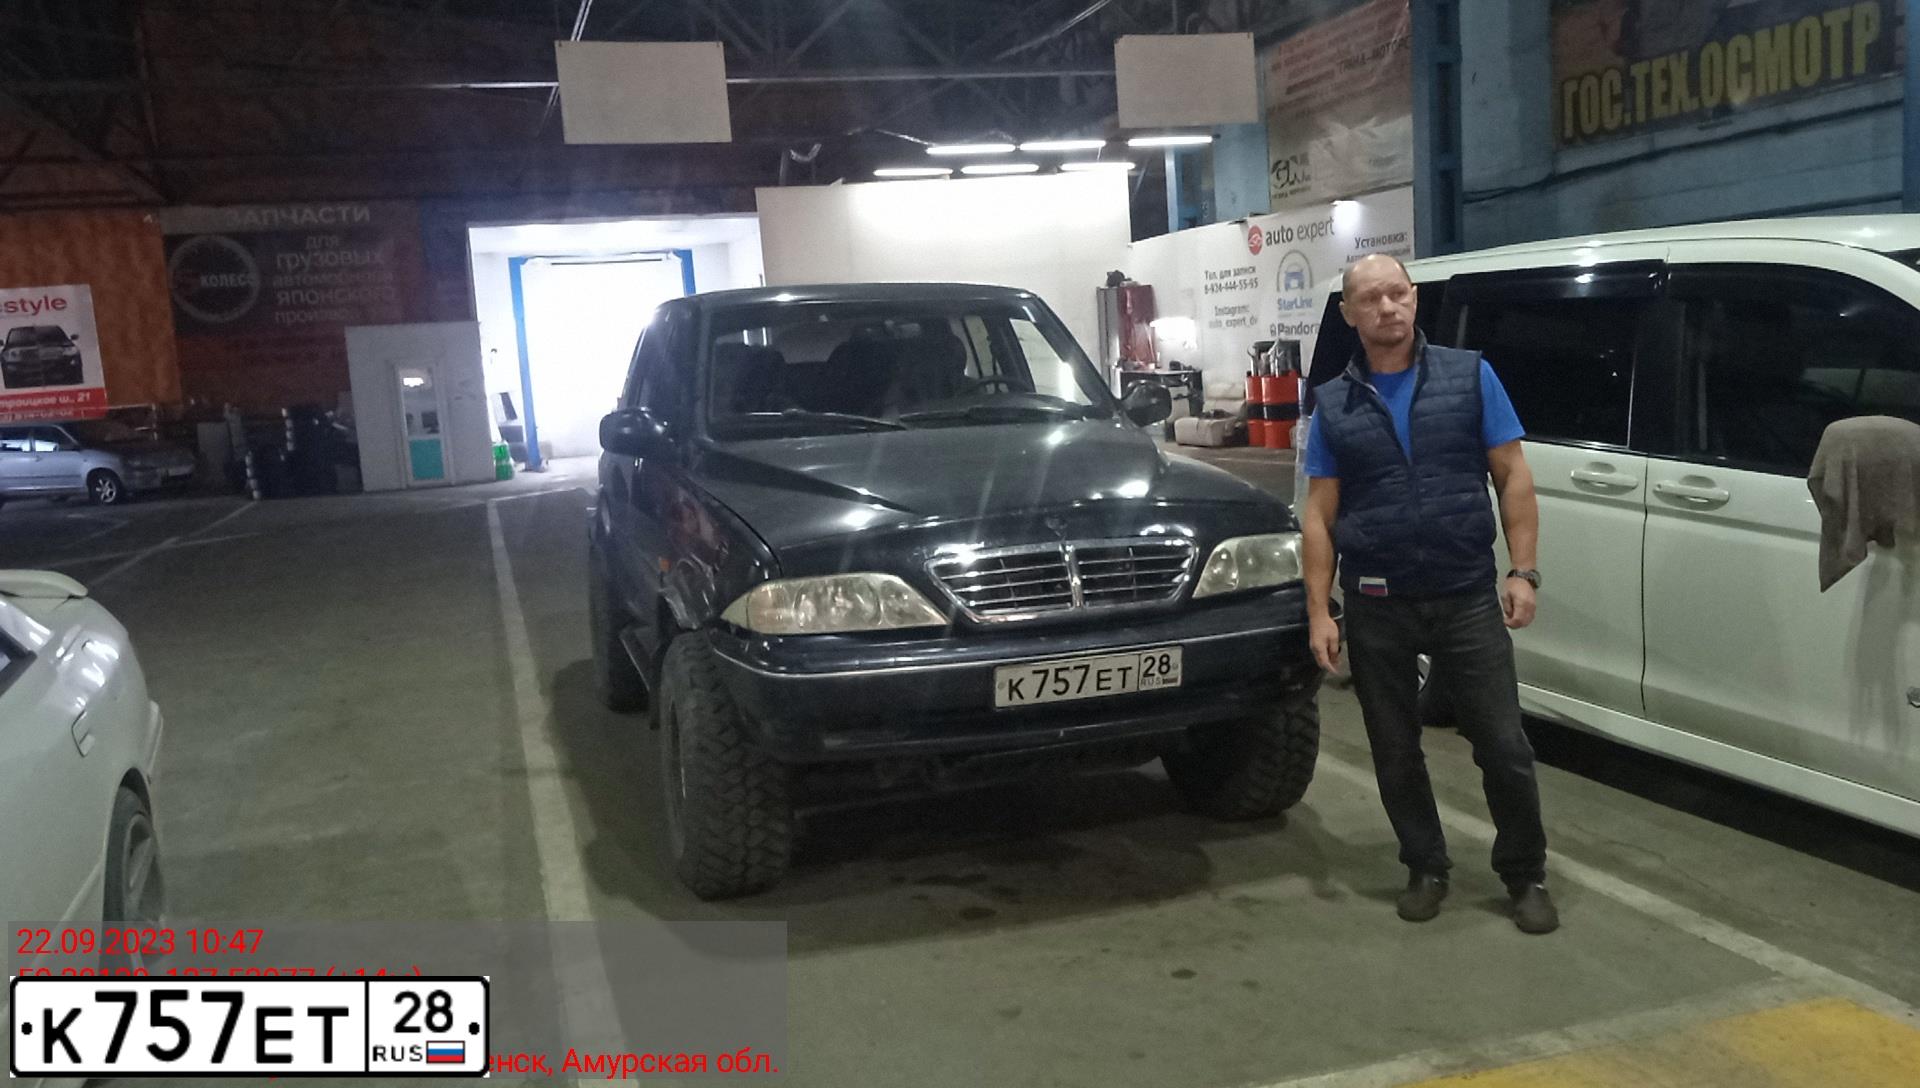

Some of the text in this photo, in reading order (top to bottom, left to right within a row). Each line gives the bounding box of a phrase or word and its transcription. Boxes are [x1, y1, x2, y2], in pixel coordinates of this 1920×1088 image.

[226, 205, 370, 226] ЗАПЧАСТИ
[1265, 216, 1335, 247] auto expert
[1355, 232, 1408, 249] Установка:
[305, 235, 339, 250] для
[276, 250, 385, 272] грузовых
[0, 294, 67, 315] style
[1277, 297, 1313, 312] StarLine
[77, 392, 90, 403] 21
[1007, 653, 1171, 701] К757ЕТ 28
[1140, 676, 1162, 687] RUS
